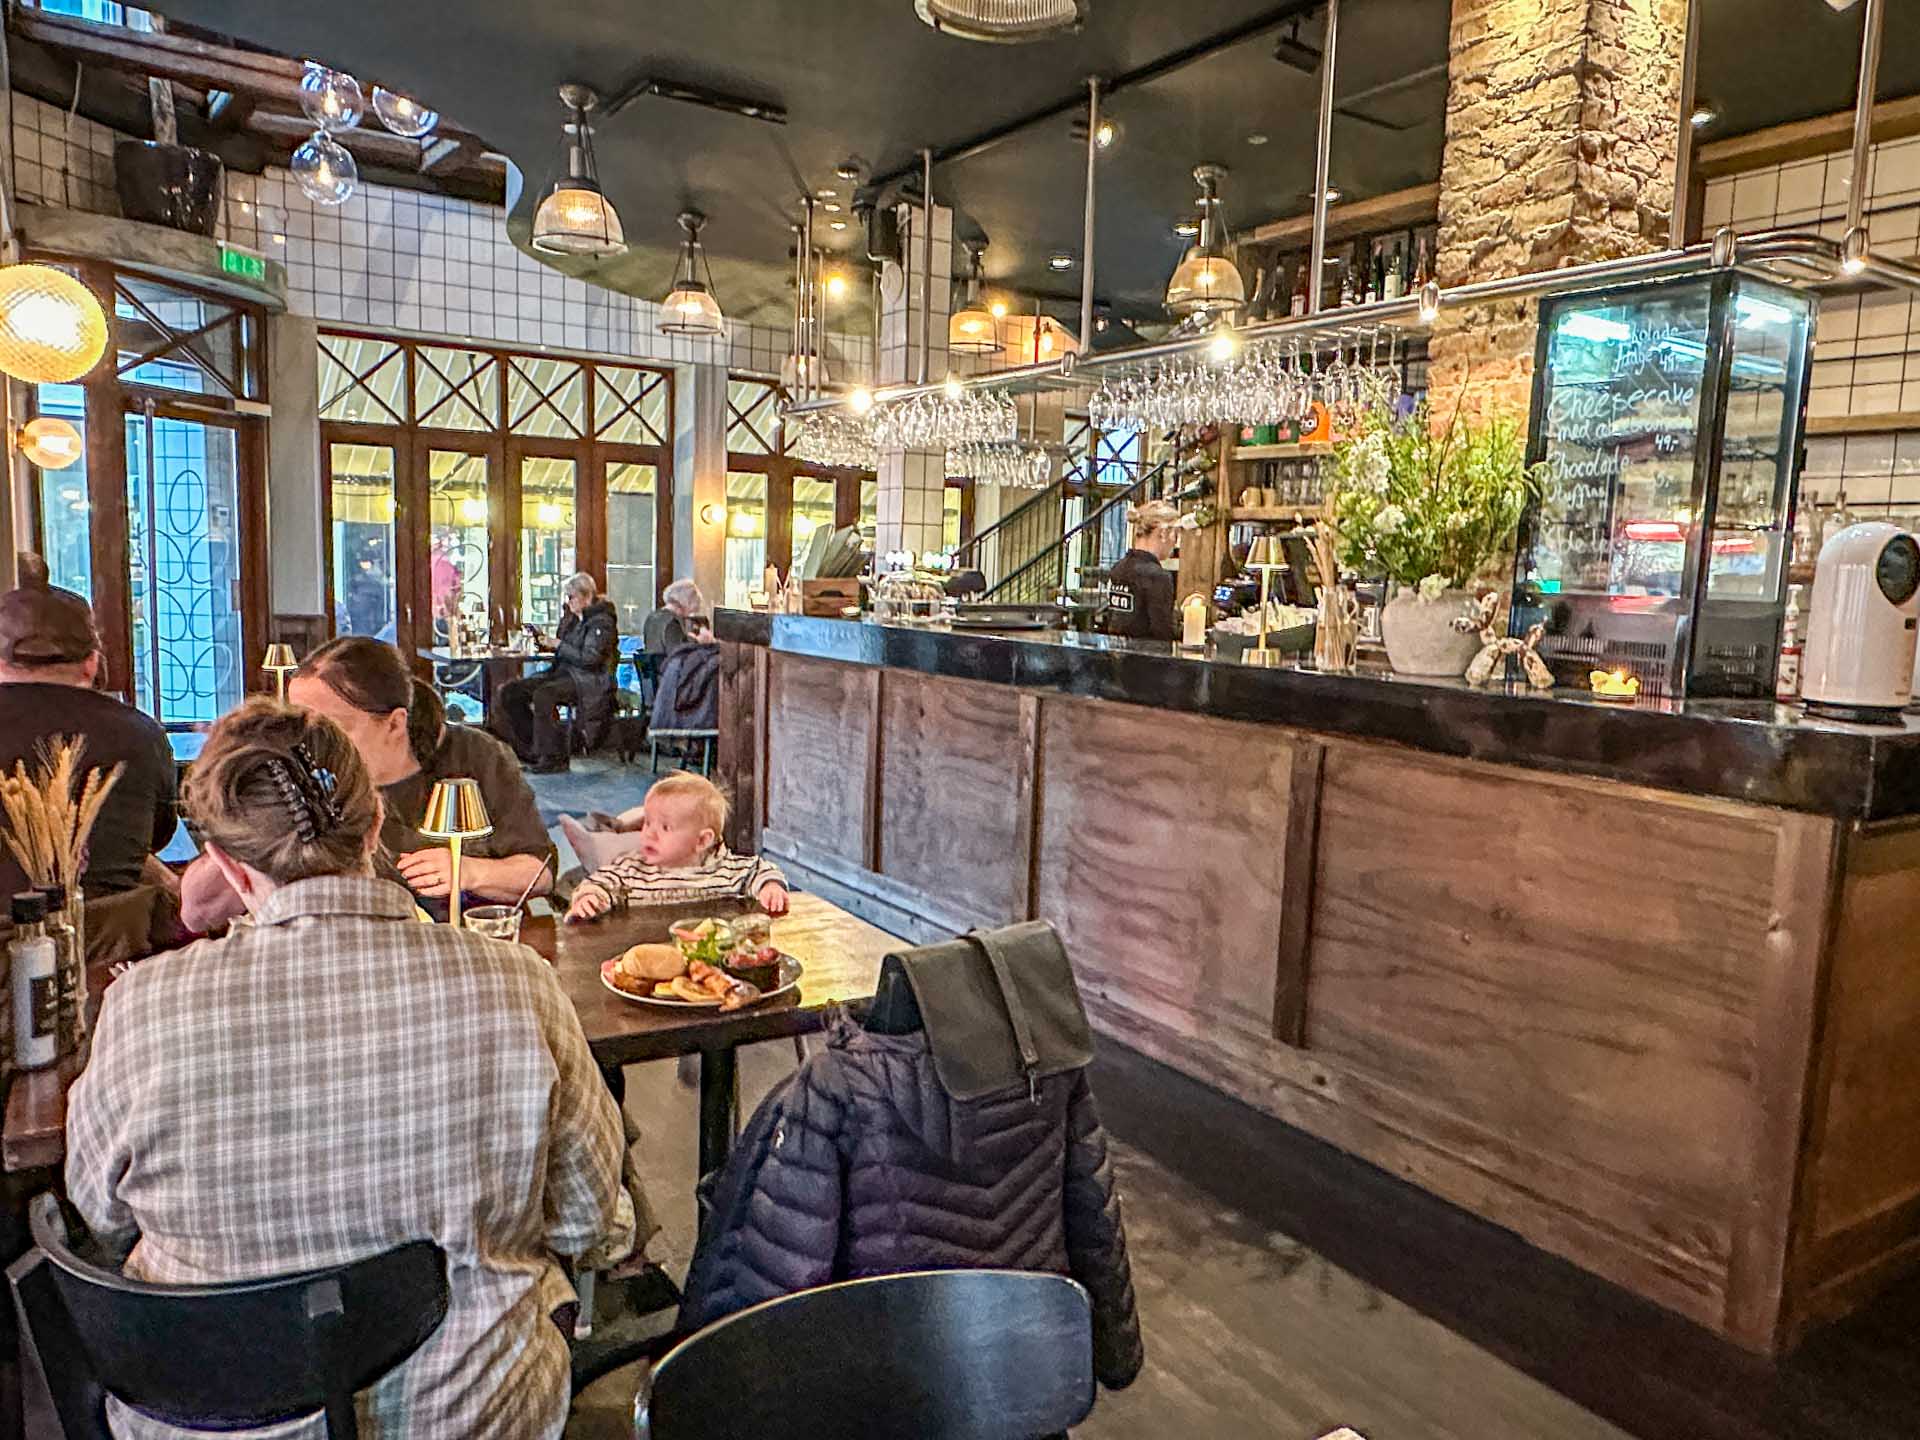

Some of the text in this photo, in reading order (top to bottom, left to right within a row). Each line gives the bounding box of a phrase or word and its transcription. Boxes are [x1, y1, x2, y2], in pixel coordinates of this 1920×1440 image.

[1547, 382, 1694, 422] Cheesecake
[1557, 418, 1591, 442] med
[1655, 434, 1679, 451] 49,-
